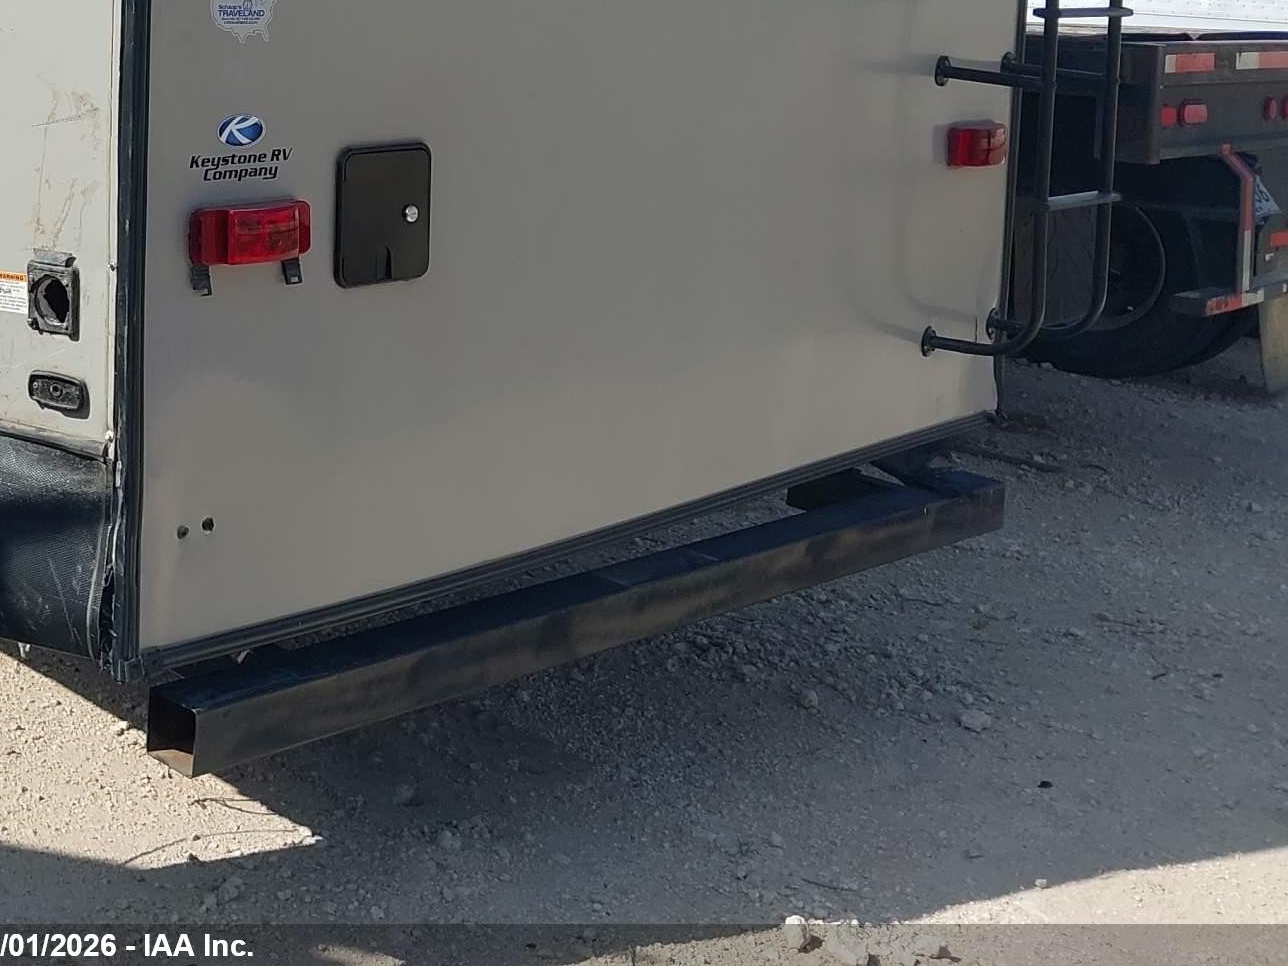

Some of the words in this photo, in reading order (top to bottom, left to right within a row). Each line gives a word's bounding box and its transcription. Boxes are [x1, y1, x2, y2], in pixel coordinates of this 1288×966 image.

[217, 9, 265, 17] TRAVELAND
[189, 153, 267, 170] Keystone
[270, 147, 292, 162] RV
[203, 166, 279, 182] Company
